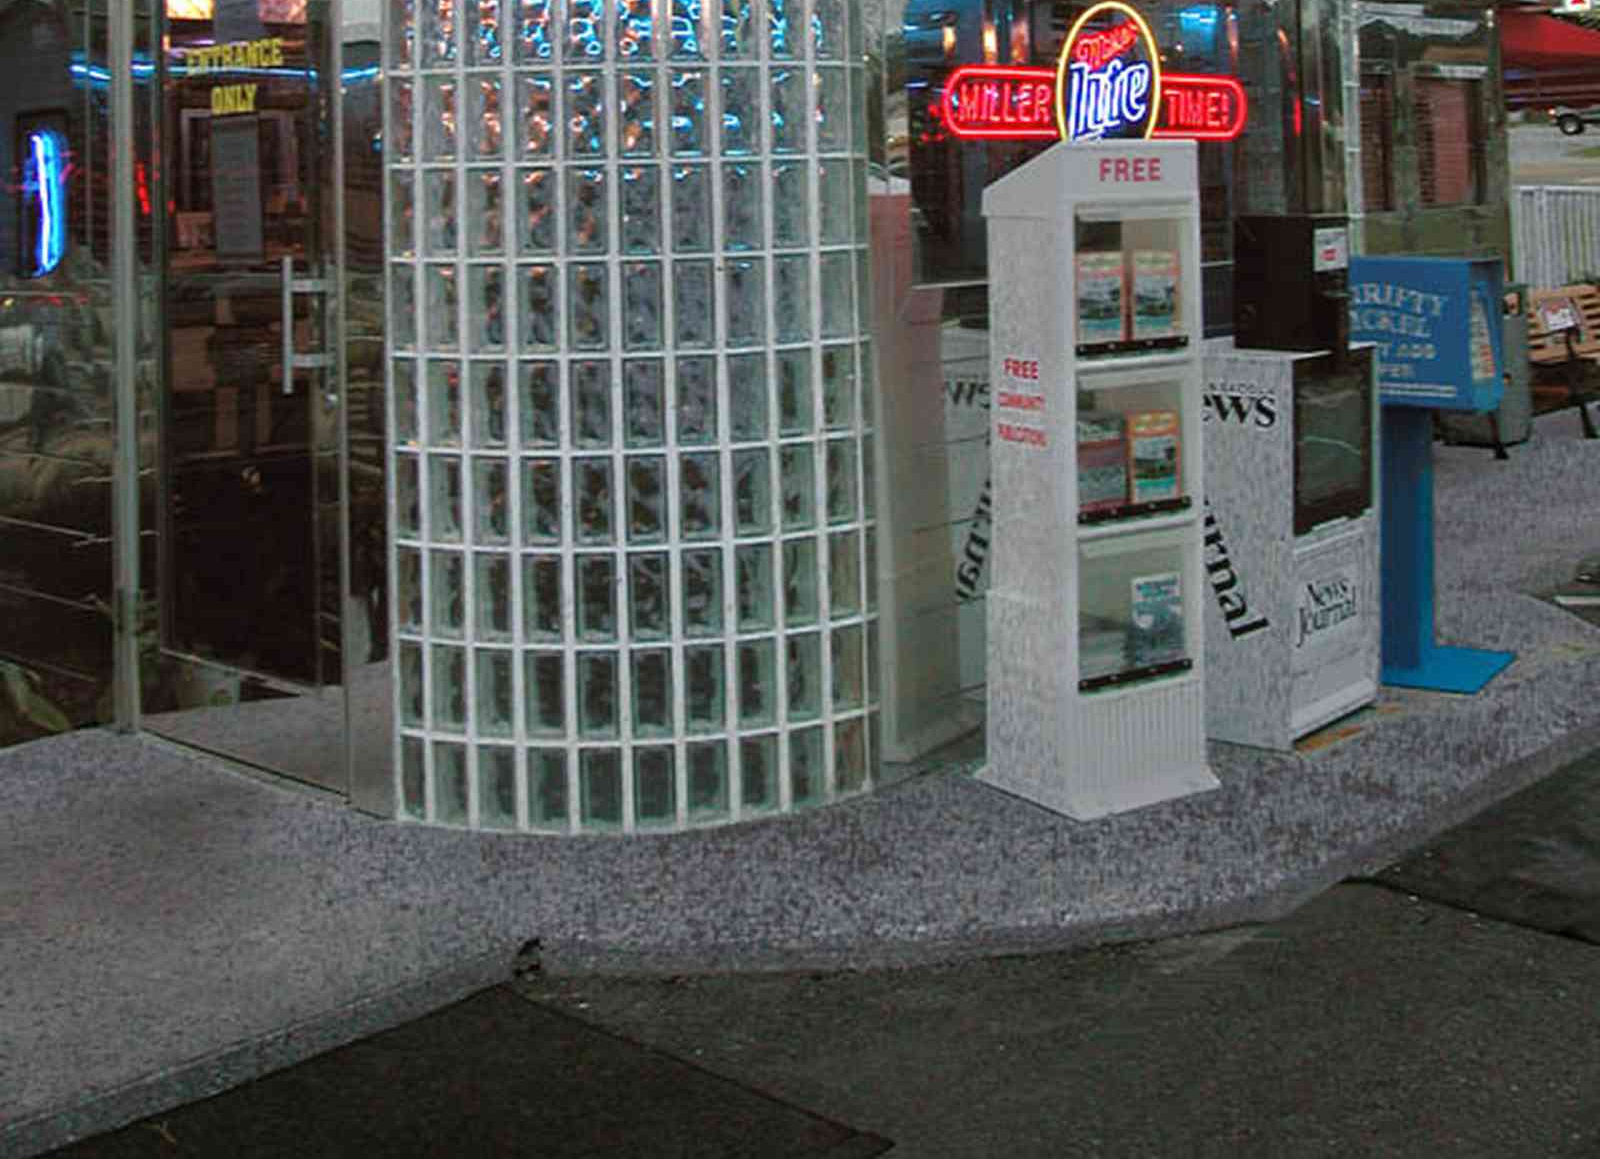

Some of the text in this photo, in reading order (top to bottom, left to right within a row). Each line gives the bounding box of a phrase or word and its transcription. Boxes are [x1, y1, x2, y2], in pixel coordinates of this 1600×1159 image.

[186, 38, 284, 75] ENTRANCE
[211, 83, 258, 115] ONLY
[958, 82, 1230, 127] MILLER TIME!
[1099, 157, 1161, 182] FREE
[1003, 357, 1039, 379] FREE
[1204, 495, 1270, 642] rnal
[1305, 577, 1350, 607] News
